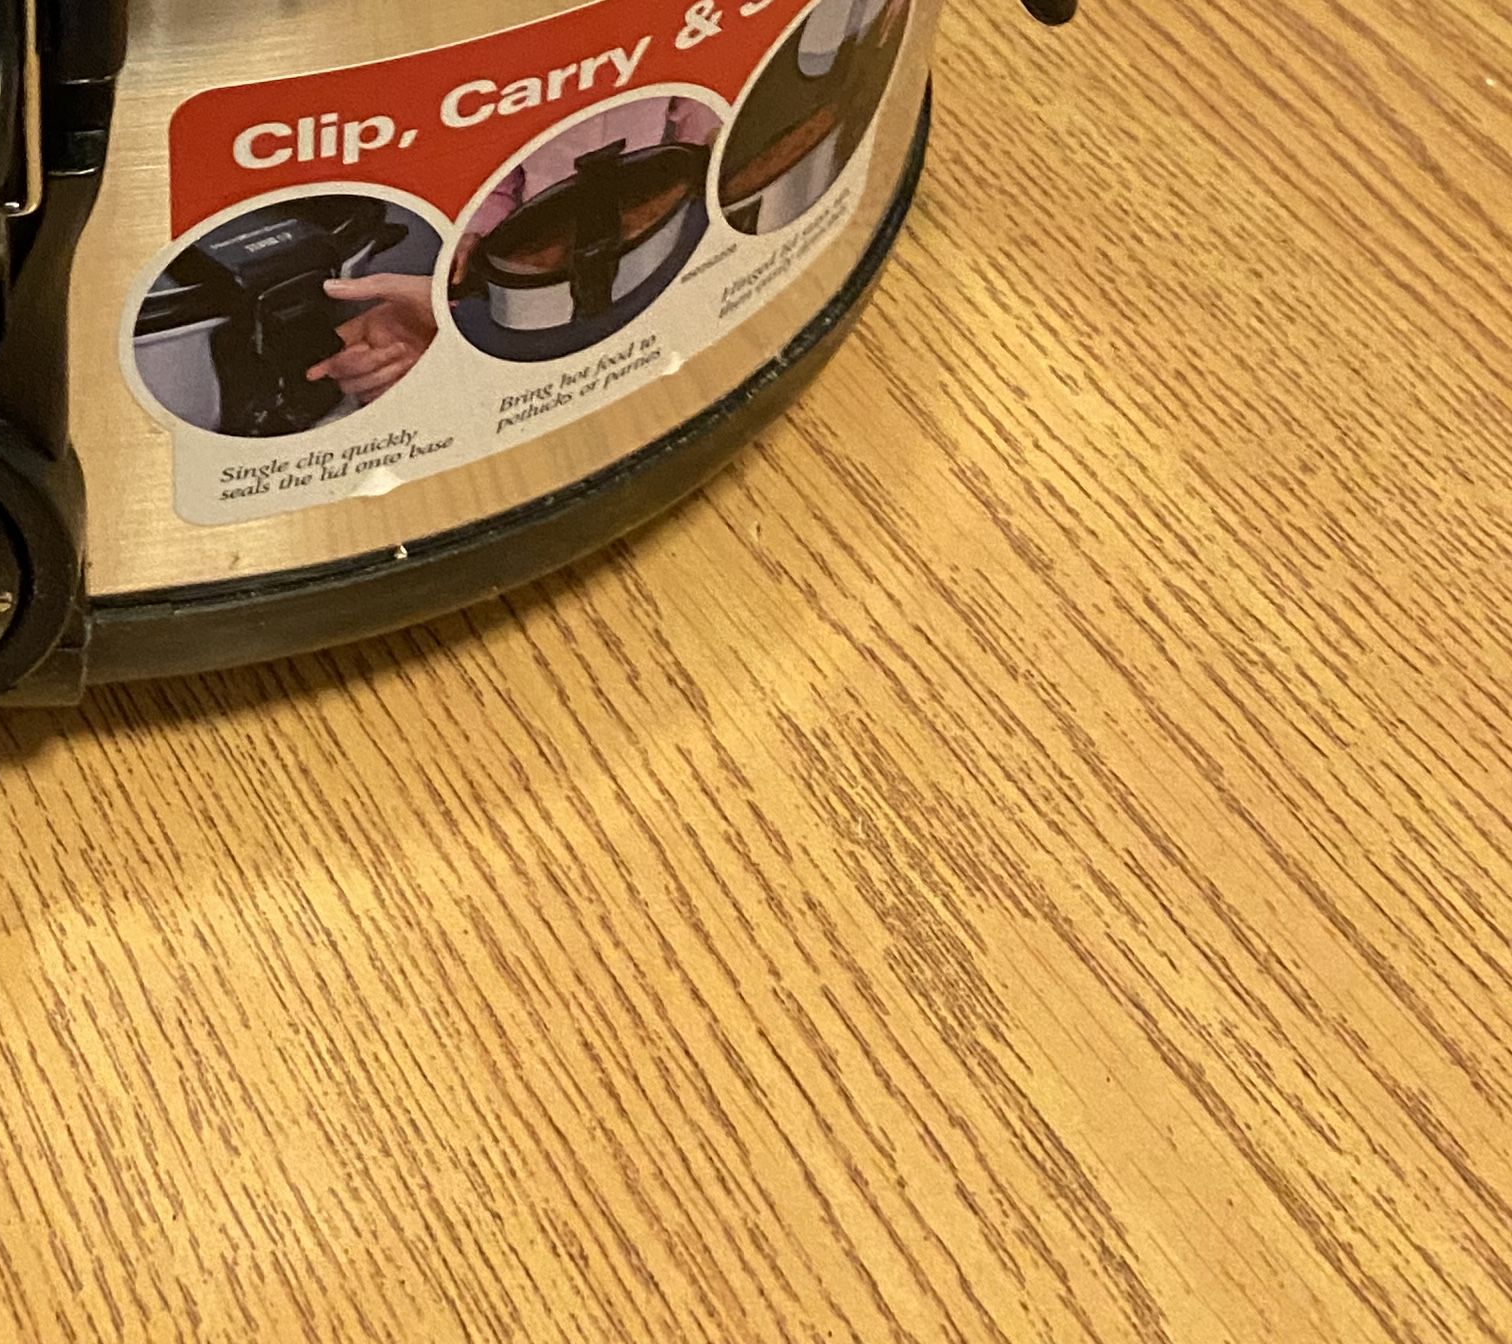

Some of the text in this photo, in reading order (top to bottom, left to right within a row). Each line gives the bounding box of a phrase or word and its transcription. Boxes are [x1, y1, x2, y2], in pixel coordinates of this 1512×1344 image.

[231, 112, 418, 169] Clip,
[439, 35, 653, 129] Carry
[498, 383, 554, 413] Bring
[559, 366, 591, 389] hot
[593, 342, 635, 377] food
[579, 378, 600, 397] or
[603, 348, 662, 389] parties
[218, 435, 455, 501] seals the lid onto base
[219, 428, 419, 484] Single clip quickly
